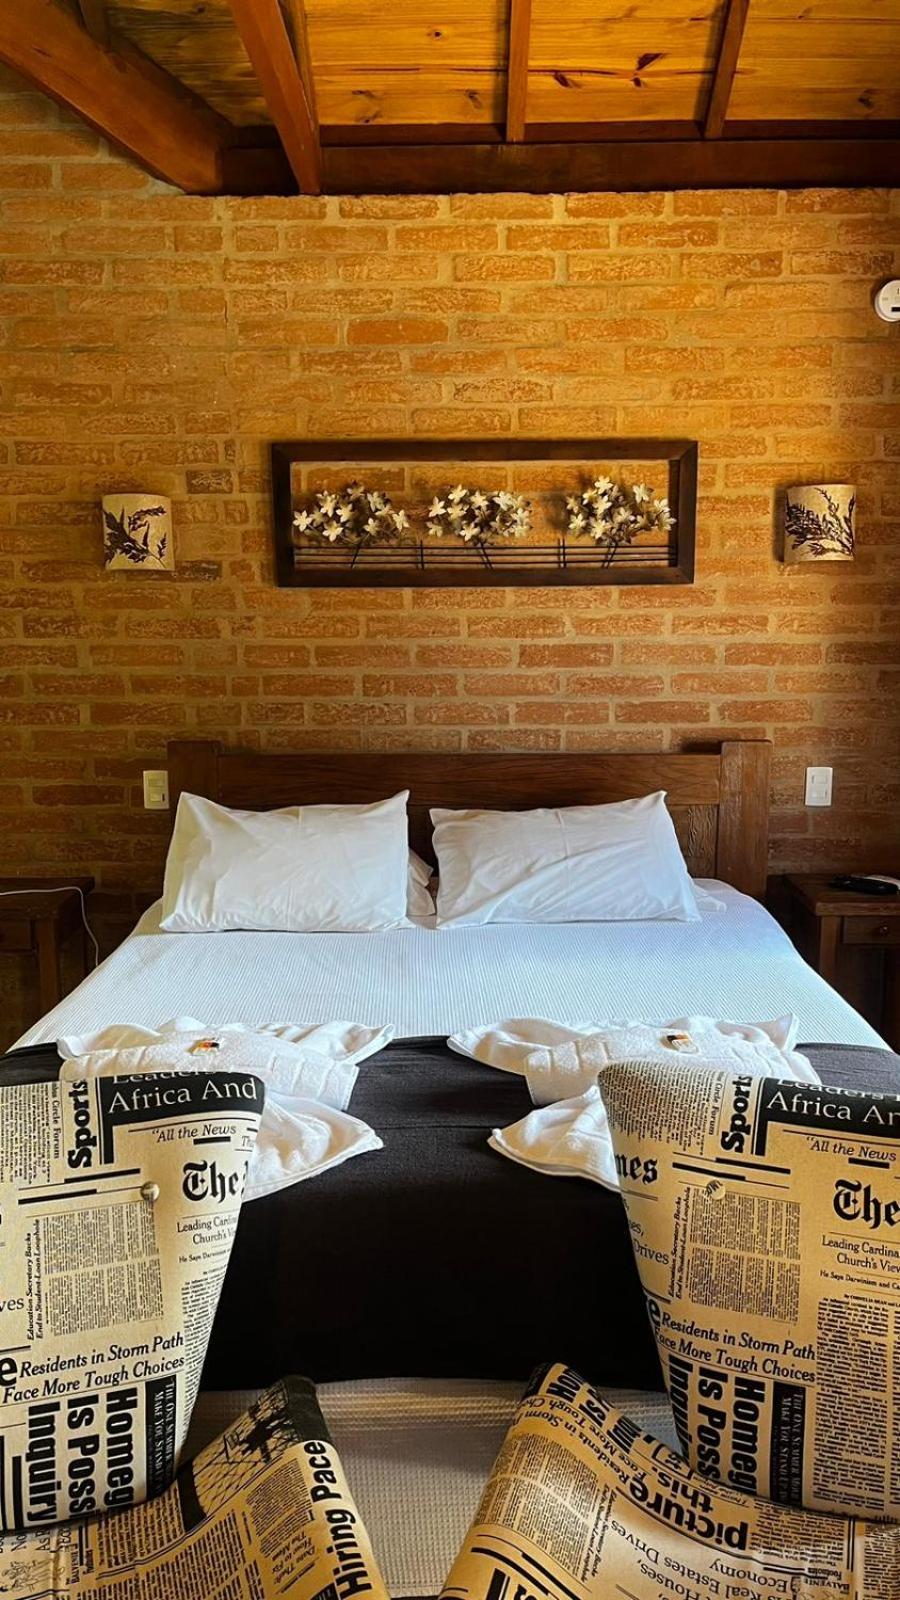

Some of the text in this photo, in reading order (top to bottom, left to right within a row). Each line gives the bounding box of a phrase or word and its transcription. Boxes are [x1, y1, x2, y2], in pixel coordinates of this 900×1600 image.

[108, 1077, 257, 1114] Africa And
[721, 1075, 752, 1153] Sports
[766, 1090, 852, 1120] Africa
[67, 1078, 97, 1169] Sports
[178, 1127, 198, 1139] the
[202, 1123, 237, 1136] News
[832, 1143, 855, 1156] the
[858, 1146, 897, 1161] News
[182, 1159, 239, 1203] The
[177, 1218, 212, 1233] Leading
[832, 1179, 900, 1229] The
[822, 1235, 860, 1253] Leading
[837, 1252, 878, 1269] Church's
[20, 1332, 183, 1378] Residents in Storm Path
[661, 1311, 815, 1361] Residents in Storm Path
[3, 1356, 185, 1404] Face More Tough Choices
[678, 1338, 712, 1361] More
[716, 1349, 758, 1374] Tough
[762, 1358, 815, 1382] Choices
[697, 1366, 728, 1400] Is
[67, 1394, 99, 1429] Is
[525, 1410, 563, 1428] Storm
[549, 1399, 585, 1429] Tough
[564, 1421, 578, 1437] in
[104, 1387, 138, 1508] Homeg
[588, 1426, 617, 1456] More
[727, 1376, 765, 1495] Homeg
[25, 1401, 61, 1521] Inquiry
[579, 1433, 629, 1485] Residents
[651, 1466, 713, 1514] this.
[303, 1441, 373, 1600] Hiring Pace
[629, 1478, 748, 1551] picture
[611, 1519, 660, 1565] Drives
[637, 1558, 701, 1600] Houses,
[664, 1556, 720, 1594] Estates
[708, 1558, 789, 1593] Economy
